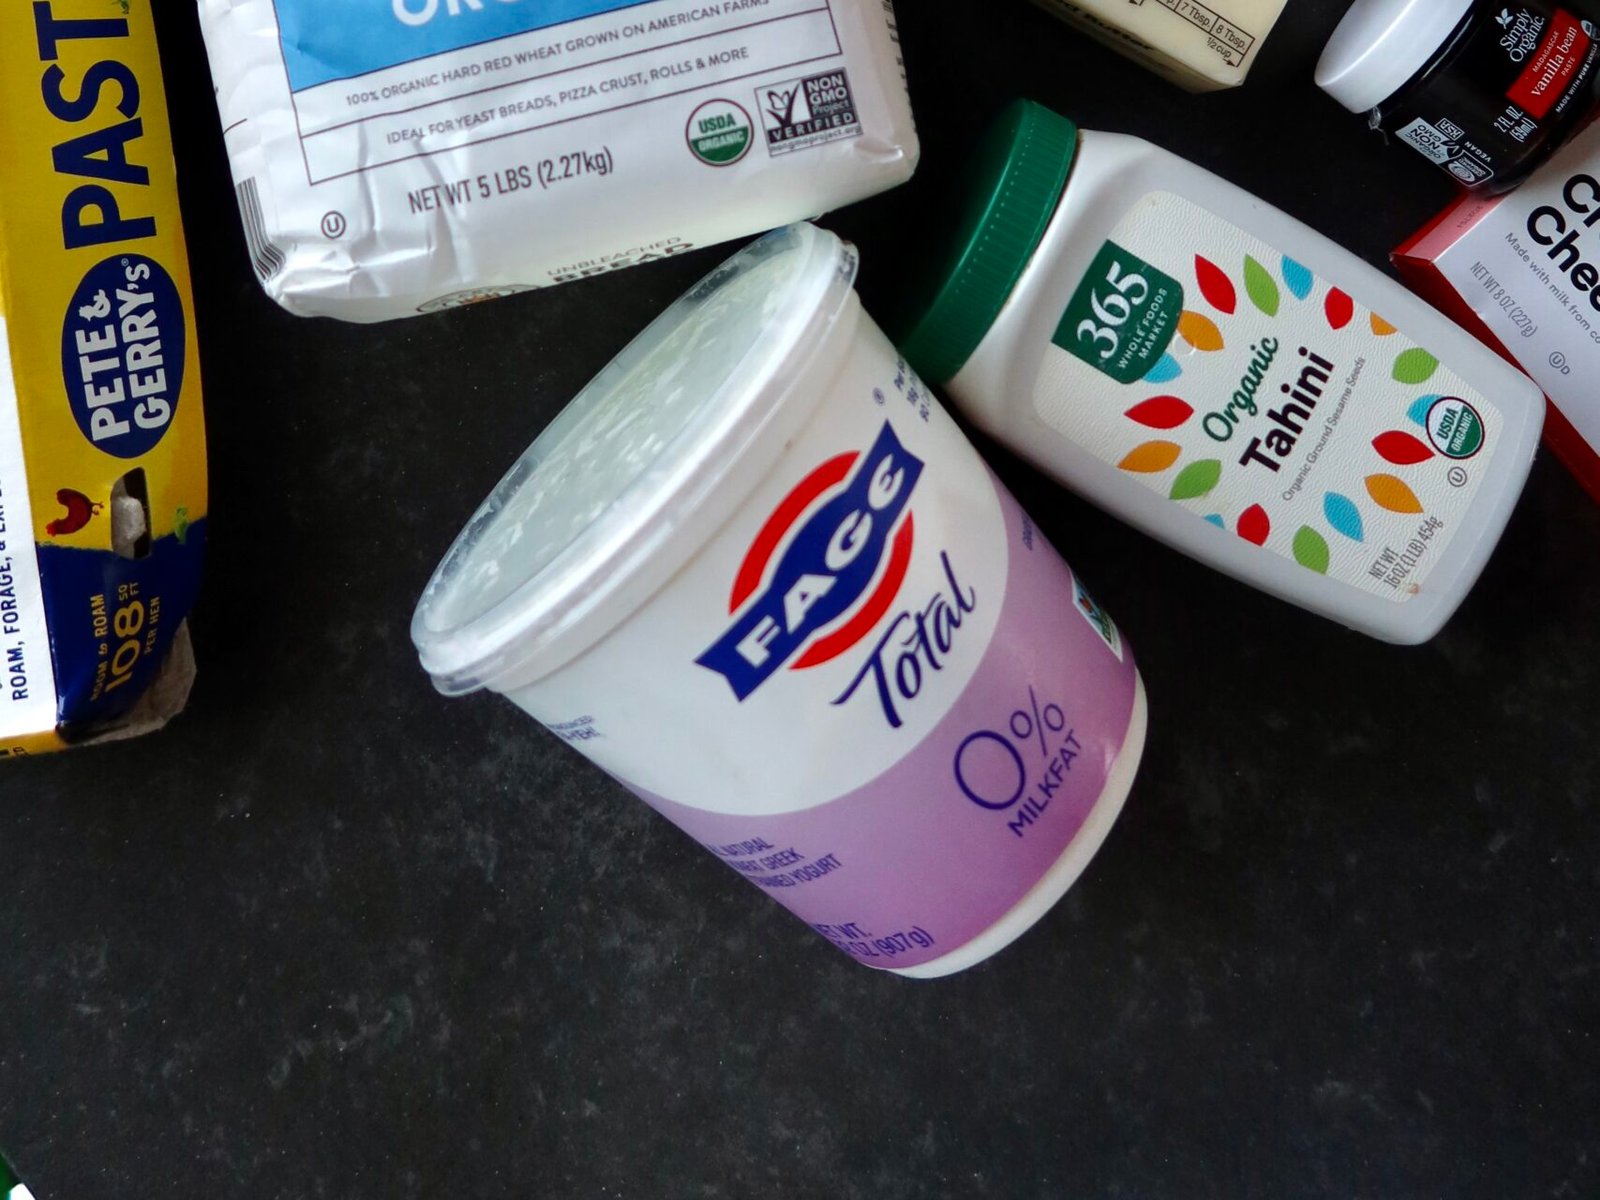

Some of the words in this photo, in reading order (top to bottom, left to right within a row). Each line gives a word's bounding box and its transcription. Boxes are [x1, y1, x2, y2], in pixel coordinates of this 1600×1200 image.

[1500, 8, 1533, 51] Simply
[1532, 31, 1559, 73] MADAGASCAR
[346, 91, 380, 106] 100%
[381, 74, 440, 99] ORGANIC
[442, 64, 481, 83] HARD
[484, 56, 512, 73] RED
[514, 43, 562, 65] WHEAT
[565, 29, 619, 53] GROWN
[622, 23, 645, 38] ON
[648, 5, 721, 32] AMERICAN
[1531, 53, 1564, 96] vanilla
[1557, 26, 1577, 54] bean
[1561, 57, 1576, 77] PASTE
[386, 128, 425, 145] IDEAL
[428, 119, 454, 135] FOR
[457, 109, 497, 130] YEAST
[499, 94, 557, 118] BREADS,
[559, 85, 597, 104] PIZZA
[600, 71, 649, 93] CRUST,
[650, 60, 693, 81] ROLLS
[696, 58, 705, 69] &
[708, 46, 749, 66] MORE
[807, 74, 844, 93] NON
[809, 86, 848, 106] GMO
[1555, 95, 1570, 113] MADE
[1568, 79, 1581, 95] WITH
[1579, 64, 1590, 80] PURE
[698, 113, 736, 134] USDA
[772, 112, 854, 141] VERIFIED
[812, 100, 849, 116] Project
[698, 131, 745, 151] ORGANIC
[1464, 141, 1491, 162] VEGAN
[408, 185, 442, 215] NET
[445, 179, 473, 206] WT
[477, 176, 491, 199] 5
[495, 165, 533, 194] LBS
[537, 145, 614, 190] (2.27kg)
[1505, 232, 1530, 263] Made
[1529, 262, 1550, 287] with
[1549, 283, 1571, 307] milk
[1568, 304, 1591, 331] from
[1077, 261, 1149, 359] 365
[1118, 325, 1145, 369] WHOLE
[1142, 288, 1168, 327] FOODS
[1507, 305, 1539, 339] (227g)
[115, 262, 171, 431] GERRY'S
[1138, 311, 1168, 359] MARKET
[75, 328, 130, 441] PETE
[1202, 337, 1279, 442] Organic
[1238, 346, 1334, 473] Tahini
[1282, 462, 1312, 501] Organic
[1306, 425, 1333, 464] Ground
[1326, 387, 1353, 427] Sesame
[1346, 356, 1366, 387] Seeds
[1437, 407, 1459, 440] USDA
[1451, 411, 1473, 452] ORGANIC
[735, 453, 904, 668] FAGE
[130, 582, 139, 596] FT
[149, 596, 160, 624] HEN
[90, 594, 108, 637] ROAM
[105, 600, 144, 692] 108
[144, 628, 158, 655] PER
[830, 551, 976, 729] Total
[7, 640, 28, 701] ROAM,
[954, 685, 1065, 810] 0%
[1007, 730, 1083, 839] MILKFAT
[763, 847, 805, 872] GREEK
[792, 853, 843, 884] YOGURT
[872, 925, 935, 958] (907g)
